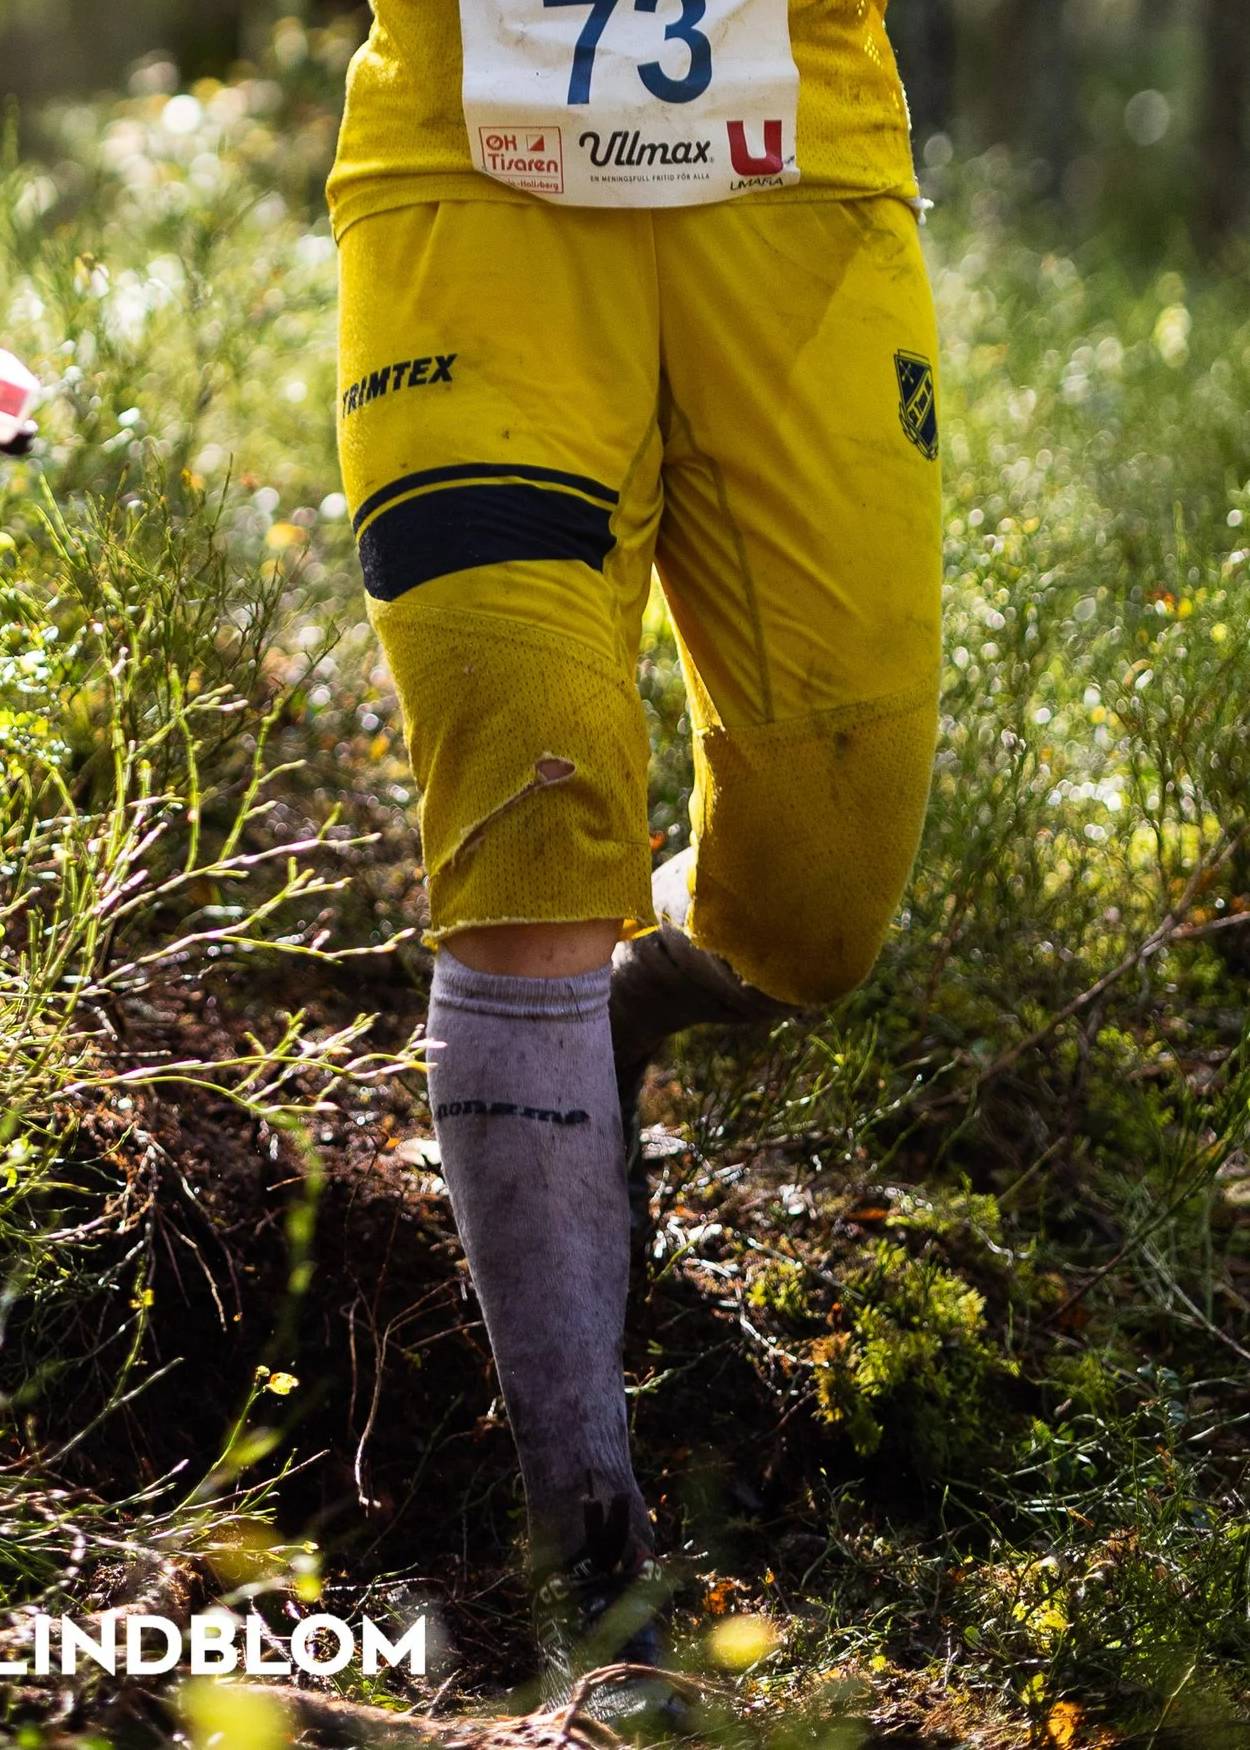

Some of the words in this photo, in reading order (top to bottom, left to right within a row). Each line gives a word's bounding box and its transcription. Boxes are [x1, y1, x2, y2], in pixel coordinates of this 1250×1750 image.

[488, 153, 559, 172] Tisaren
[578, 130, 711, 167] Ullmax
[602, 174, 650, 183] MENINGSFULL
[652, 174, 675, 182] FRITID
[676, 172, 691, 181] FÖR
[693, 173, 710, 181] ALLA
[342, 353, 457, 419] TRIMTEX
